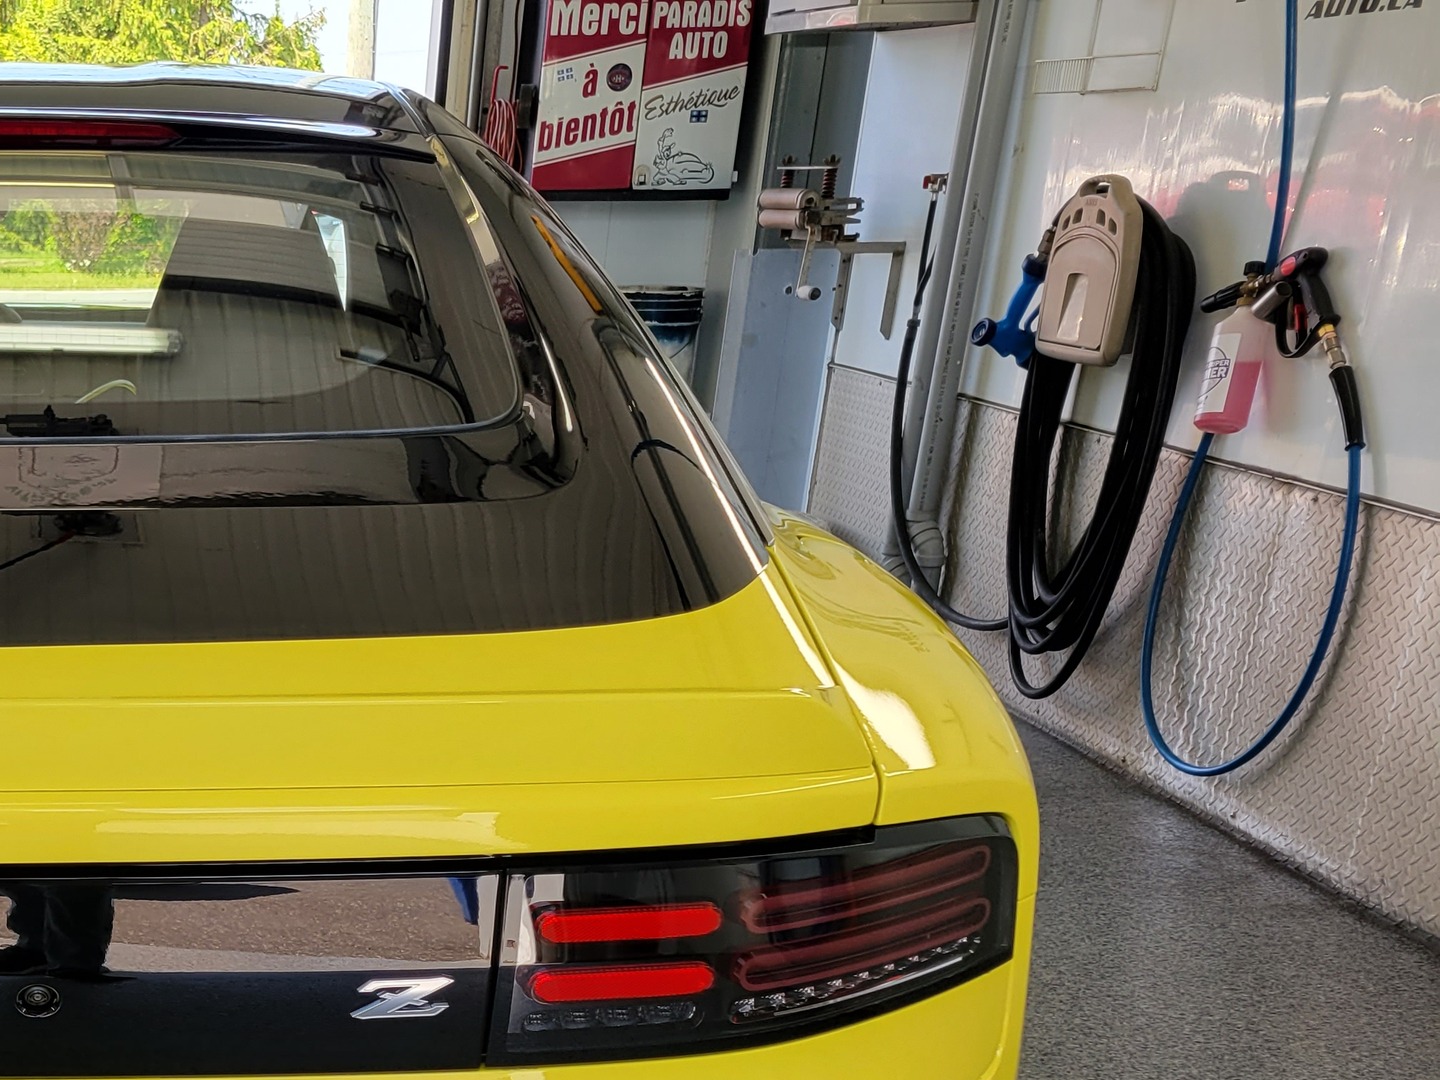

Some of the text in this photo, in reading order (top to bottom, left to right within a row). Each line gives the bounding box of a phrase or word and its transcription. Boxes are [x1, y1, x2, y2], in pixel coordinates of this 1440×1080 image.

[550, 0, 649, 36] Merci
[653, 0, 753, 29] PARADIS
[669, 31, 729, 60] AUTO
[582, 62, 599, 99] à
[644, 85, 741, 121] Esthétique
[538, 100, 637, 152] bientôt
[350, 975, 455, 1020] Z
